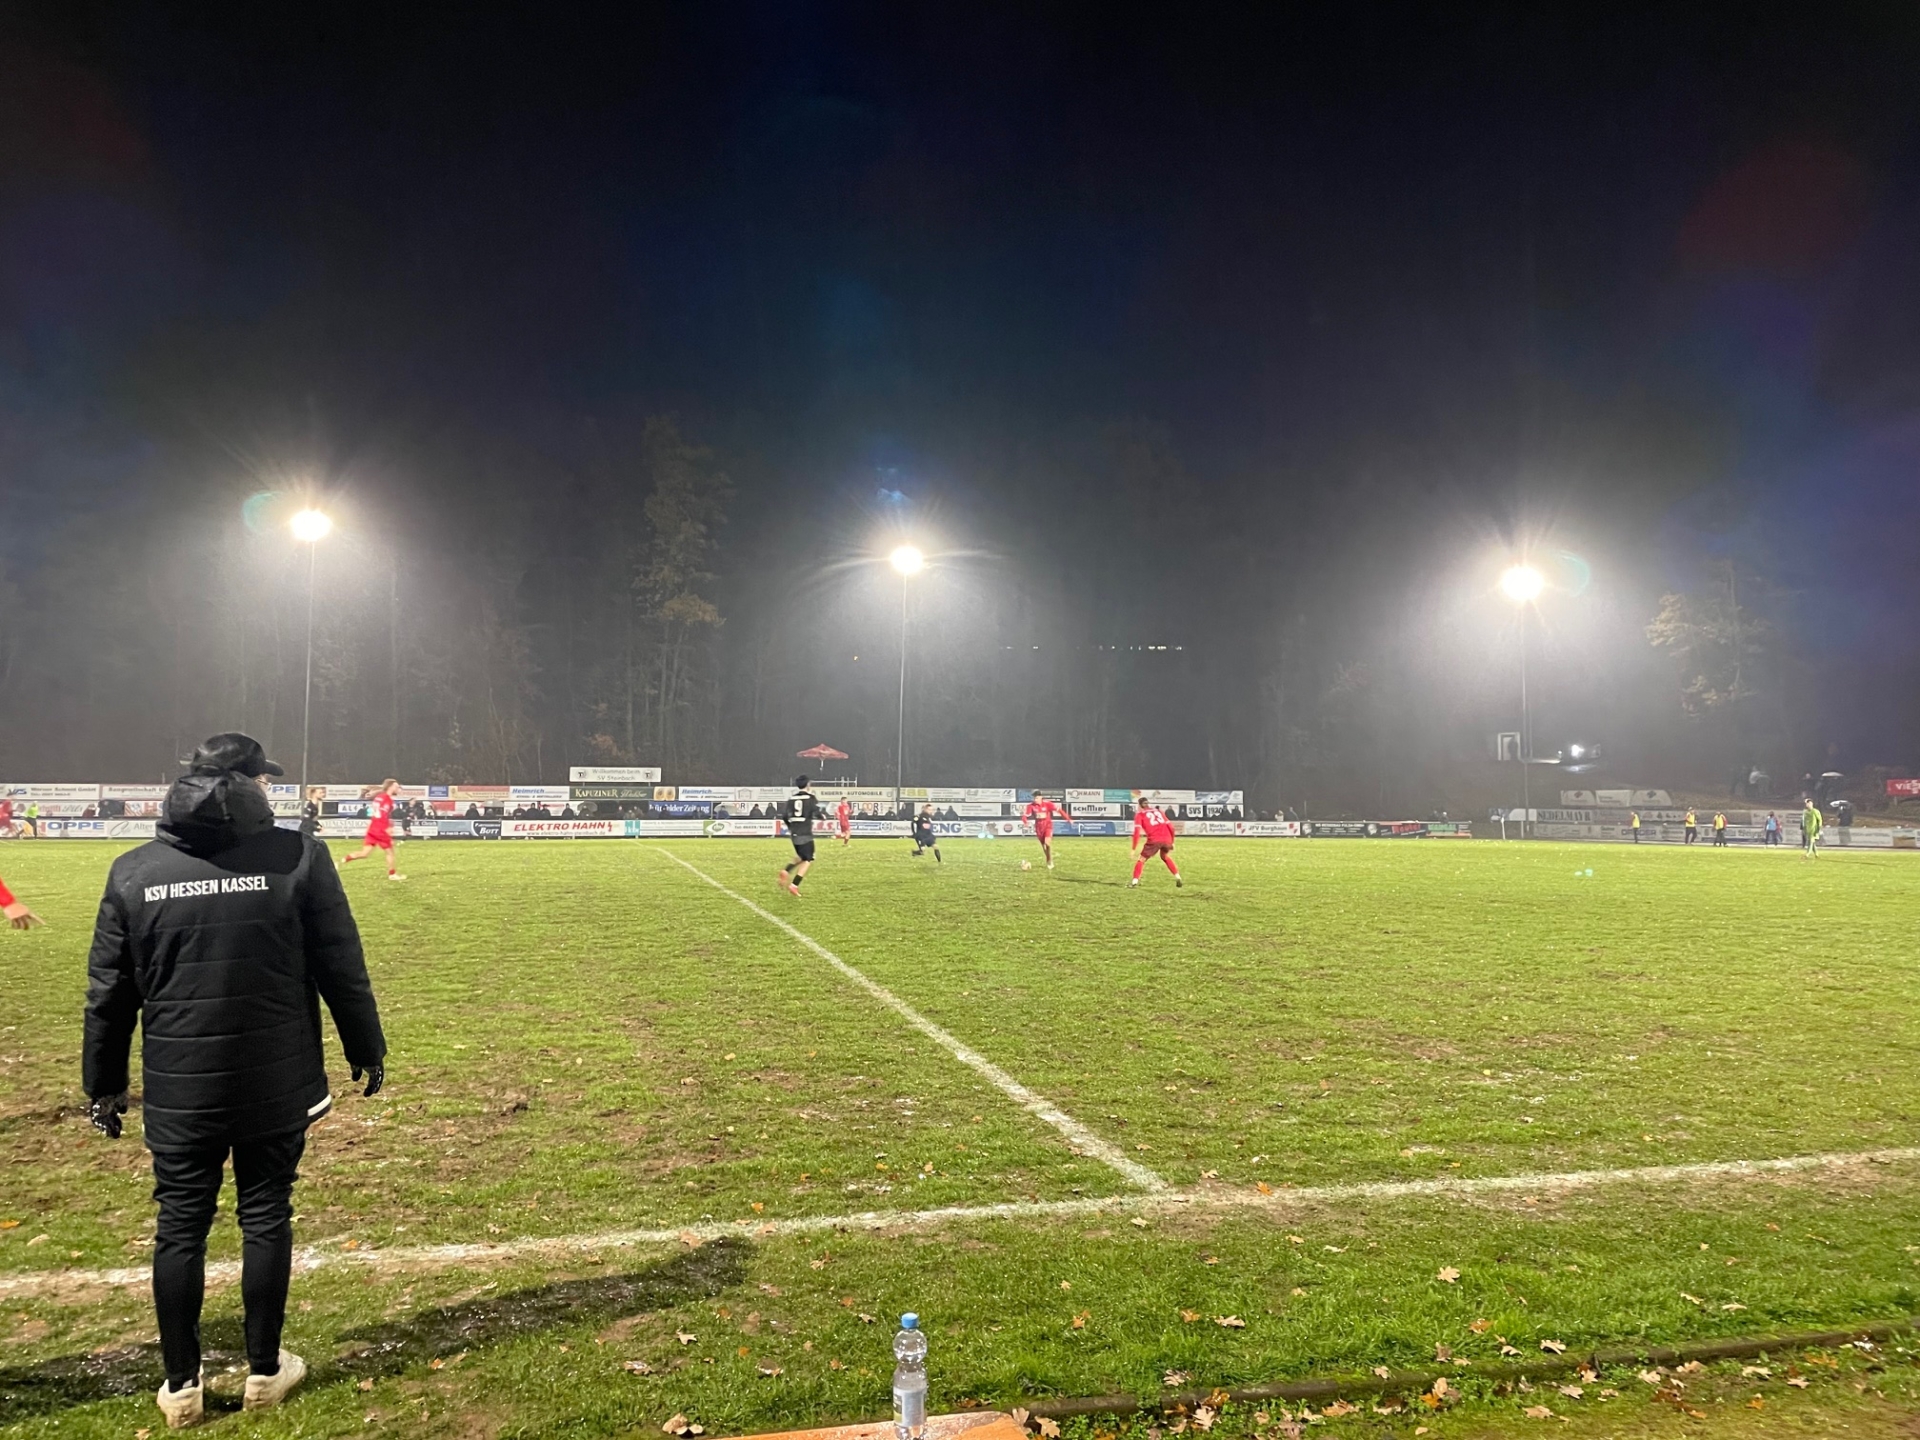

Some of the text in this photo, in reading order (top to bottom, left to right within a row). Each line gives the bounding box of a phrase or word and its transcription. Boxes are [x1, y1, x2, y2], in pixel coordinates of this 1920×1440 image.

[575, 788, 618, 798] KAPUZINER
[794, 800, 803, 817] 9
[1073, 804, 1107, 812] SCHMIDT
[1188, 807, 1202, 815] SVS
[1146, 811, 1165, 826] 23
[514, 822, 606, 832] ELEKTRO HAHN
[144, 876, 269, 902] KSV HESSEN KASSEL
